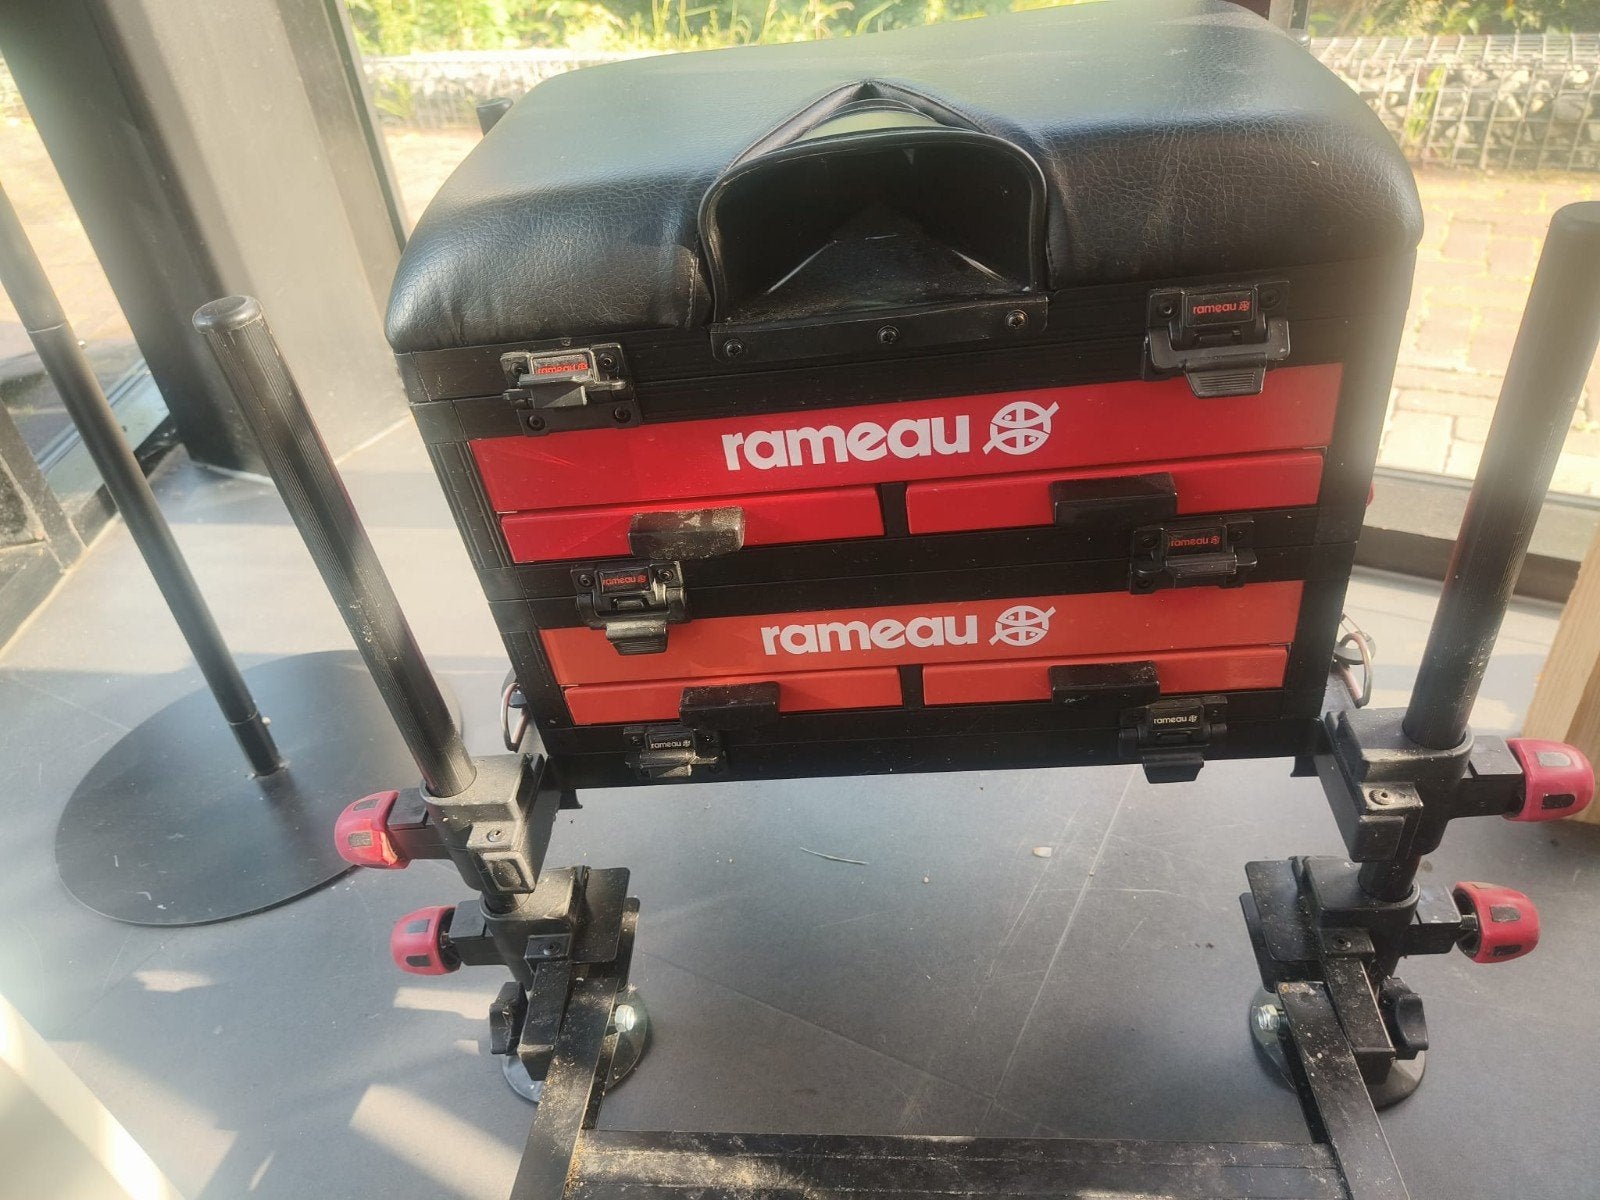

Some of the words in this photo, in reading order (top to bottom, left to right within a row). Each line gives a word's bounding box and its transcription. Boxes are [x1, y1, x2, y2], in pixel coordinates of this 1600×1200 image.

[1193, 302, 1237, 314] rameau
[721, 414, 970, 471] rameau
[1170, 537, 1209, 547] rameau
[760, 615, 978, 656] rameau
[1153, 716, 1188, 724] rameau
[650, 741, 682, 749] rameau
